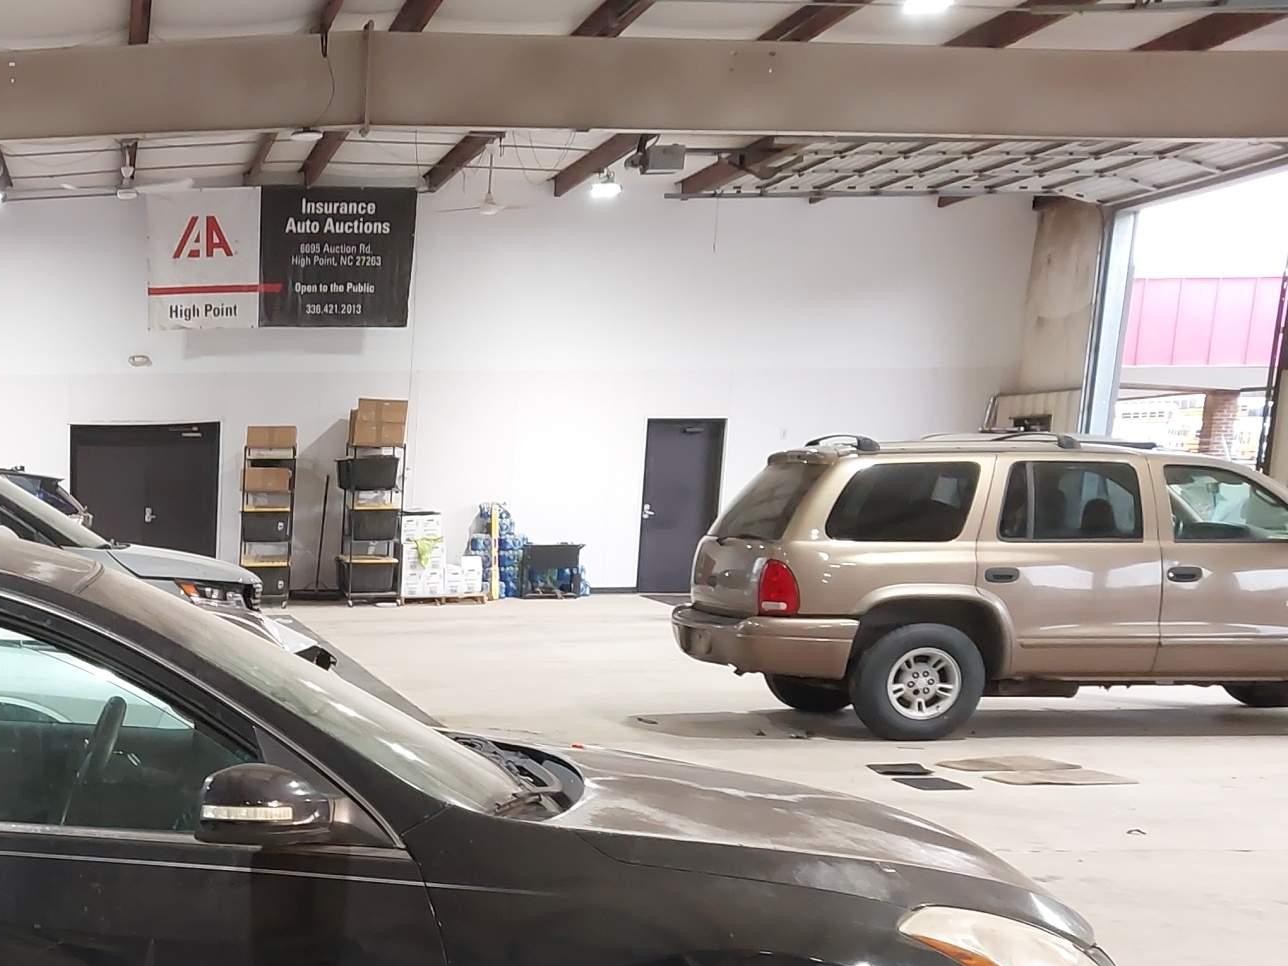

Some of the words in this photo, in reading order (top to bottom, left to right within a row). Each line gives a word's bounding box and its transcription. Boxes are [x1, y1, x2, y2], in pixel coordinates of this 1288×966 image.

[301, 197, 376, 215] Insurance
[285, 216, 320, 234] Auto
[323, 216, 391, 234] Auctions
[323, 243, 357, 254] Auction
[291, 255, 311, 268] High
[313, 255, 337, 266] Point,
[340, 255, 354, 266] NC
[295, 282, 318, 295] Open
[319, 282, 328, 293] to
[330, 282, 344, 293] the
[346, 282, 375, 293] Public
[169, 304, 200, 322] High
[204, 302, 238, 318] Point
